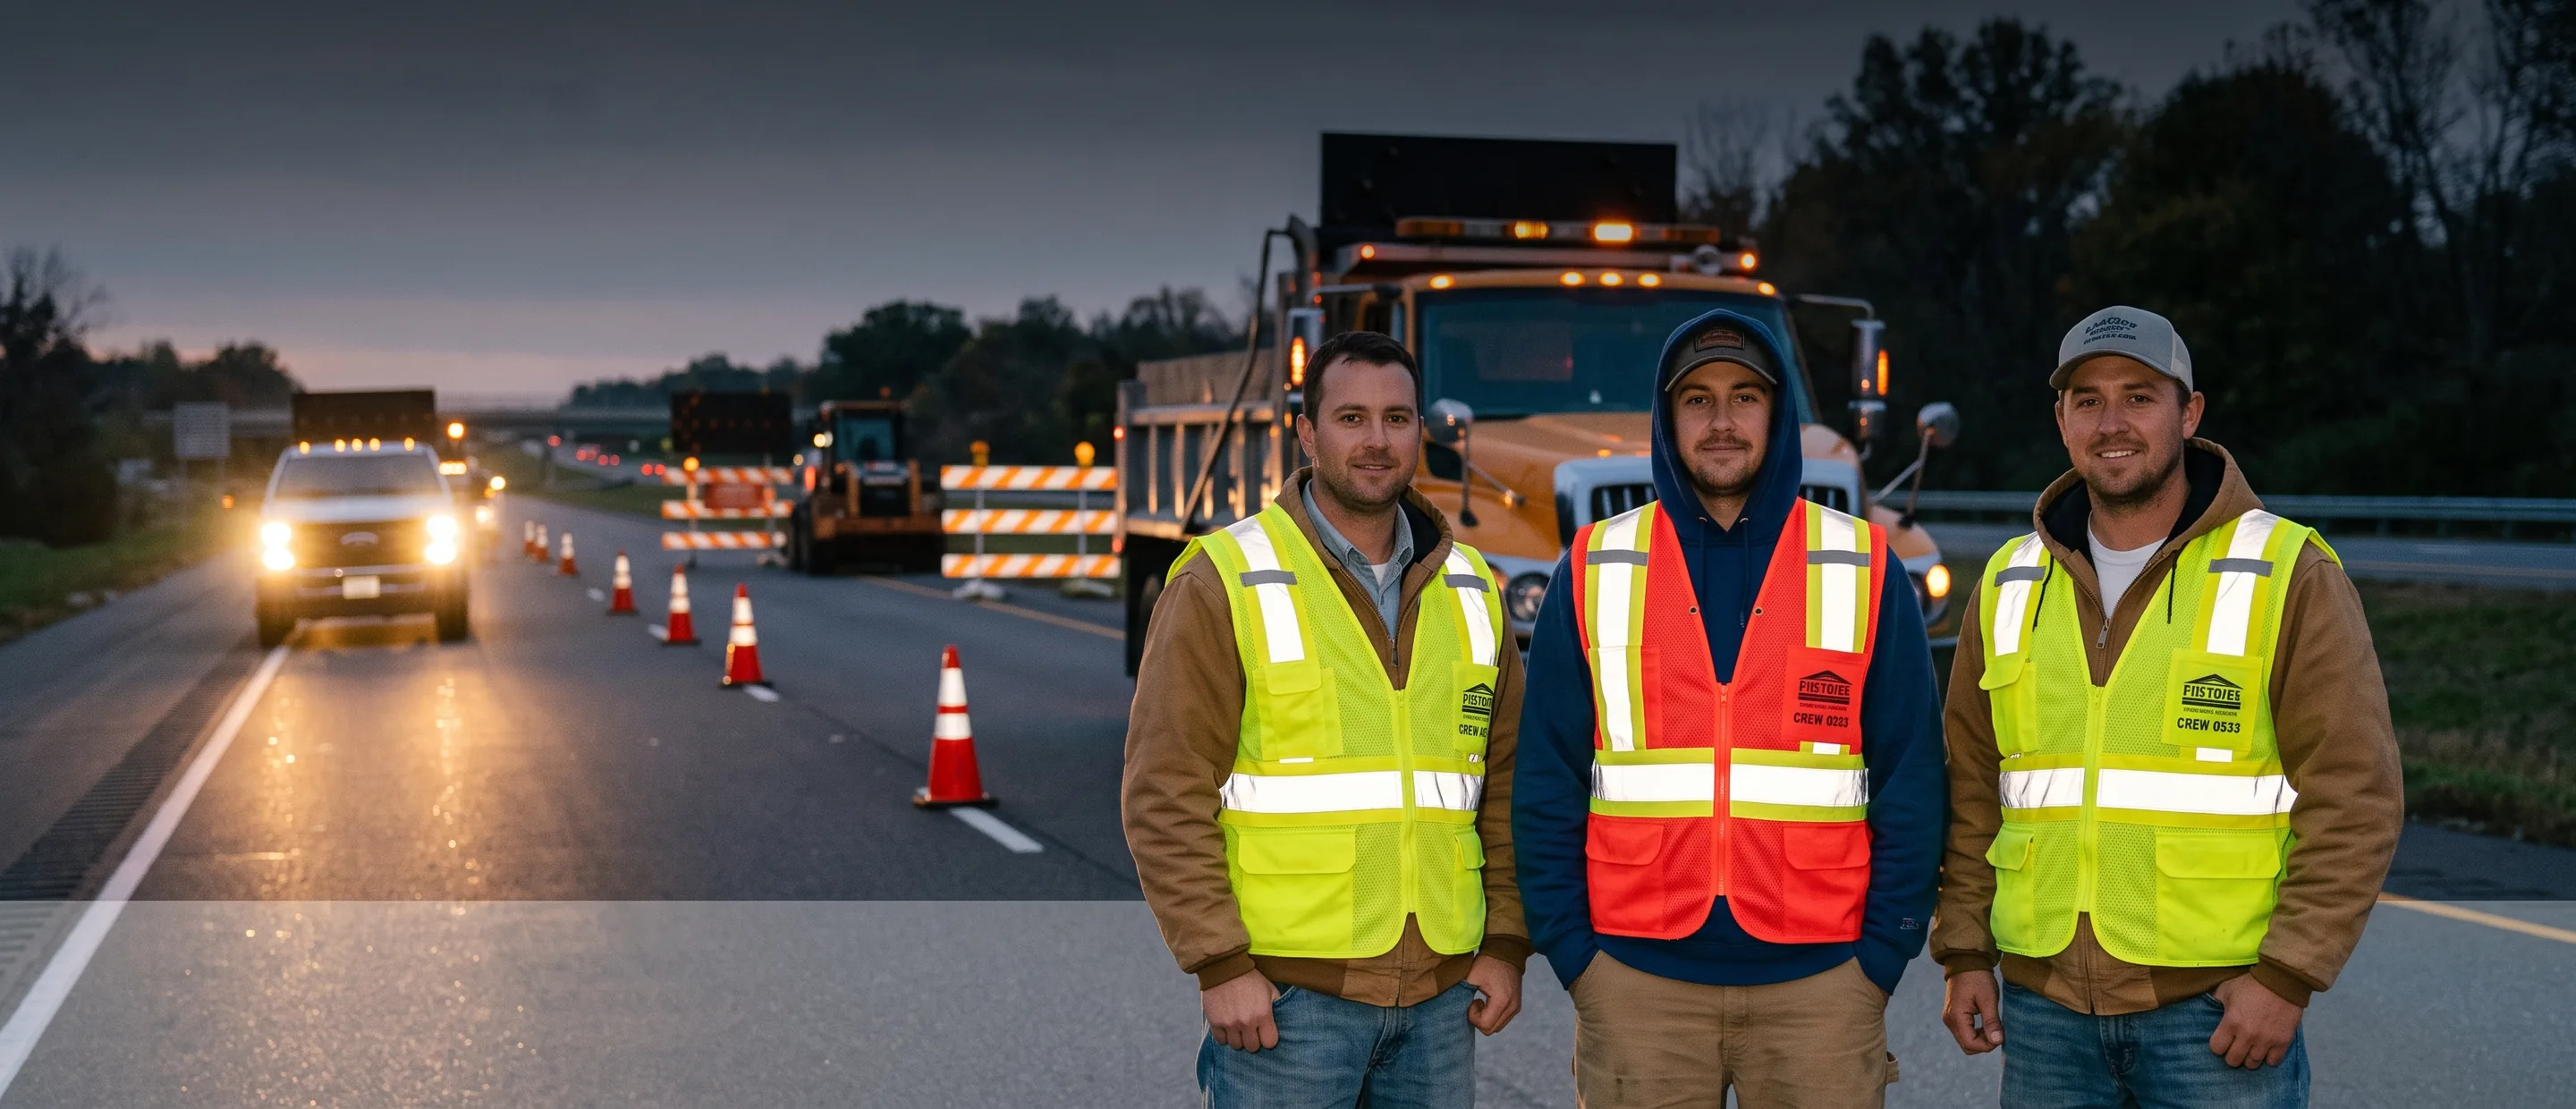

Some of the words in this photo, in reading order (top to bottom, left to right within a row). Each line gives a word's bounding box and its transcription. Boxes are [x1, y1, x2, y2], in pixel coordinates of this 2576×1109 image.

[1793, 712, 1823, 725] CREW
[2177, 717, 2210, 731] CREW
[2213, 721, 2241, 733] 0533
[1459, 724, 1479, 736] CREW
